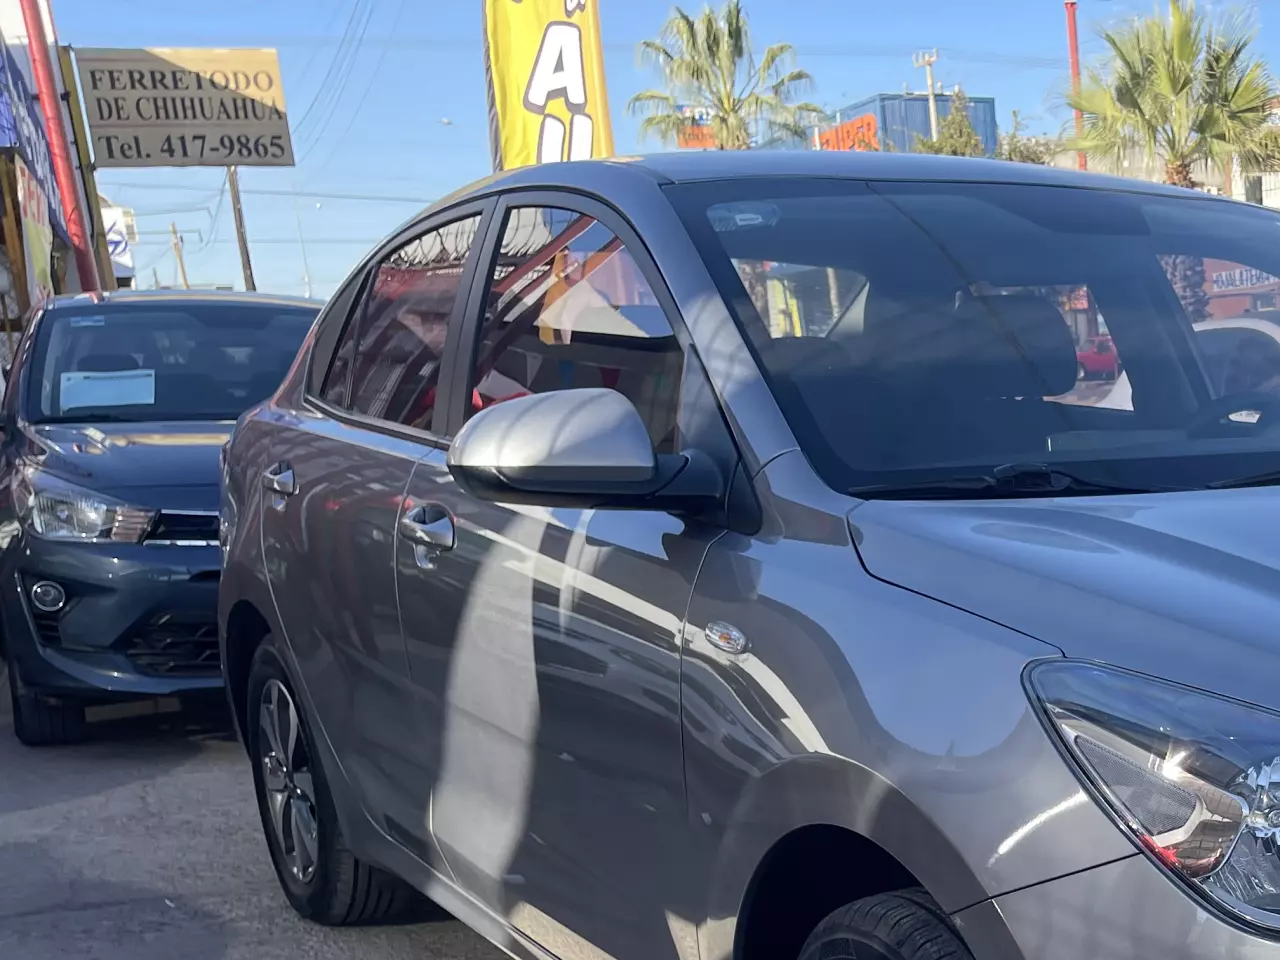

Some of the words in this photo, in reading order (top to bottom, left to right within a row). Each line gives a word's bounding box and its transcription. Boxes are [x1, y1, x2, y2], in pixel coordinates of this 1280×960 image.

[89, 69, 273, 92] FERRETODO
[96, 97, 130, 122] DE
[135, 96, 284, 122] CHIHUAHUA
[98, 135, 151, 160] Tel.
[160, 134, 285, 159] 417-9865
